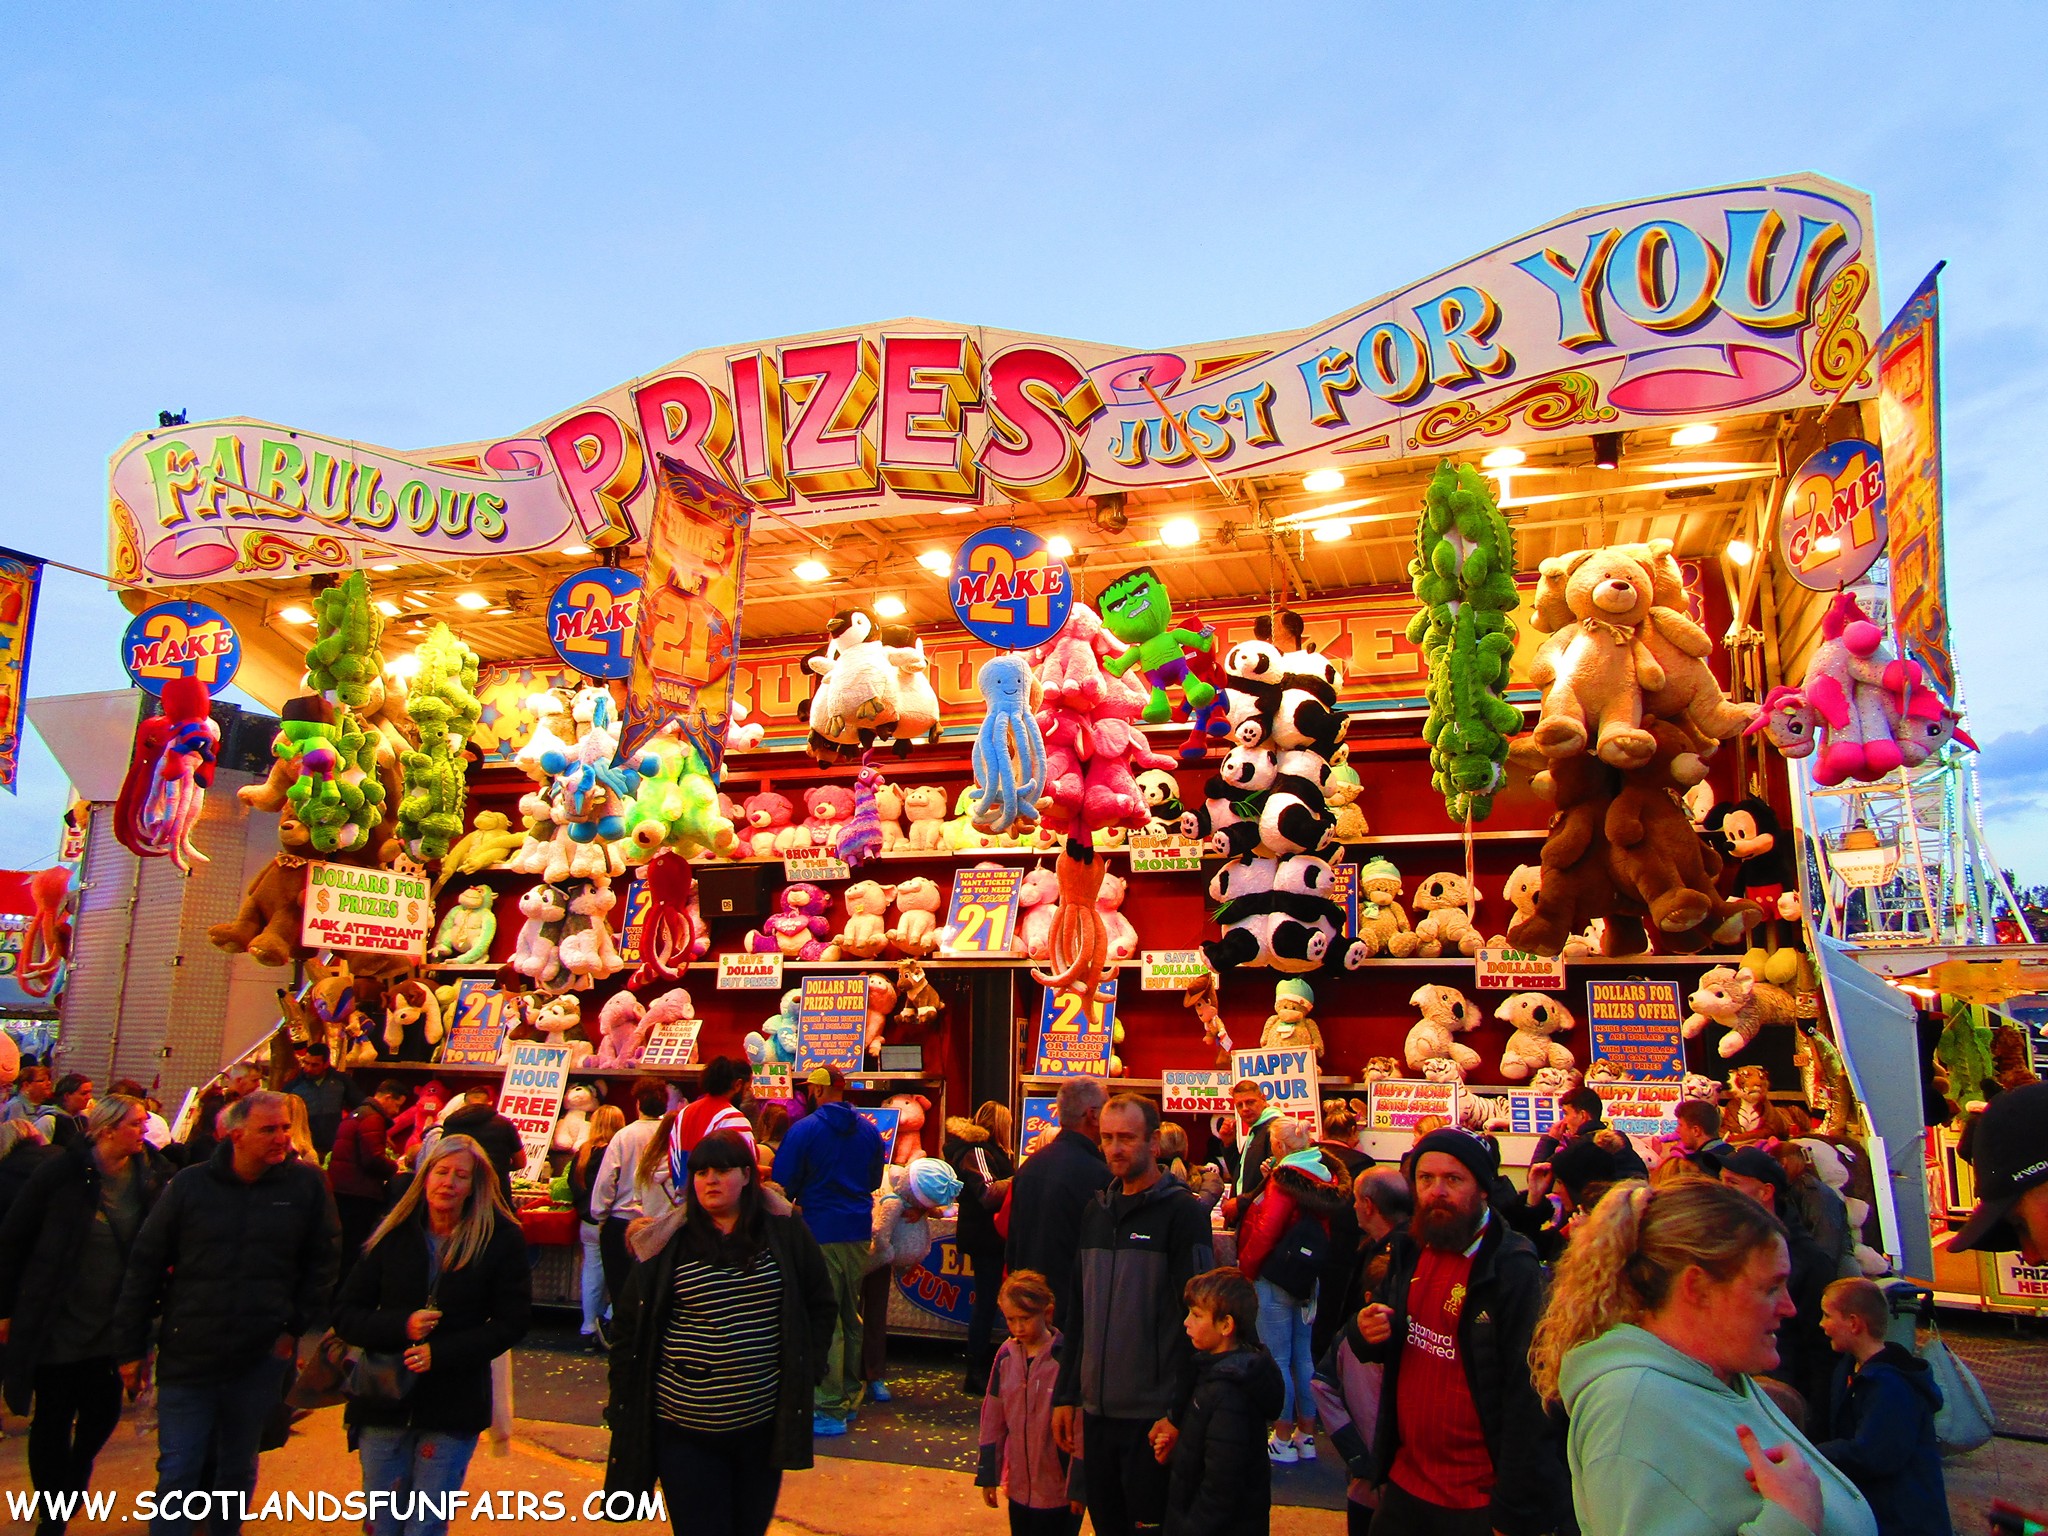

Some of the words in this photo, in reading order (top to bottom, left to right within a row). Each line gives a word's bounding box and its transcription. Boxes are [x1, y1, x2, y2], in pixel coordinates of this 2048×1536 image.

[1107, 381, 1278, 466] JUST
[1296, 285, 1516, 429] FOR
[1513, 209, 1847, 353] YOU
[541, 332, 1107, 548] PRIZES
[145, 434, 508, 542] FABULOUS
[1788, 460, 1884, 567] GAME
[1794, 450, 1877, 573] 21
[955, 565, 1065, 607] MAKE
[967, 544, 1050, 628] 21
[554, 601, 640, 643] MAK
[650, 592, 711, 683] 21
[130, 629, 233, 670] MAKE
[139, 614, 224, 684] 21
[659, 681, 691, 706] GAME
[1132, 836, 1174, 849] SHOW
[1178, 835, 1200, 847] ME
[786, 848, 821, 860] SHOW
[1152, 848, 1182, 858] THE
[803, 859, 829, 868] THE
[1133, 858, 1200, 872] MONEY
[788, 867, 846, 880] MONEY
[312, 865, 390, 894] DOLLARS
[394, 878, 426, 900] FOR
[338, 893, 399, 918] PRIZES
[308, 917, 340, 932] ASK
[344, 921, 424, 941] ATTENDANT
[950, 903, 1010, 951] 21
[323, 931, 352, 945] FOR
[355, 935, 409, 951] DETAILS
[622, 948, 640, 961] TO
[738, 955, 764, 965] SAVE
[1164, 952, 1196, 964] SAVE
[726, 966, 774, 976] DOLLARS
[1152, 965, 1209, 976] DOLLARS
[1487, 962, 1553, 974] DOLLARS
[721, 977, 742, 988] BUY
[744, 977, 779, 987] PRIZES
[806, 980, 845, 995] DOLLARS
[847, 979, 864, 994] FOR
[1145, 977, 1171, 990] BUY
[1480, 975, 1510, 988] BUY
[1512, 975, 1561, 988] PRIZES
[1593, 985, 1646, 1001] DOLLARS
[1649, 985, 1674, 1001] FOR
[459, 991, 505, 1028] 21
[803, 996, 835, 1011] PRIZES
[836, 995, 864, 1010] OFFER
[1593, 1003, 1635, 1019] PRIZES
[1638, 1003, 1677, 1020] OFFER
[452, 1027, 479, 1035] WITH
[481, 1028, 502, 1036] ONE
[1042, 1034, 1079, 1042] WITH
[1081, 1034, 1109, 1043] ONE
[1609, 1033, 1626, 1041] ARE
[453, 1042, 495, 1050] TICKETS
[1045, 1042, 1064, 1050] OR
[1066, 1043, 1104, 1051] MORE
[446, 1049, 465, 1063] TO
[467, 1050, 498, 1064] WIN
[514, 1047, 568, 1068] HAPPY
[1046, 1050, 1101, 1059] TICKETS
[769, 1064, 788, 1076] ME
[1039, 1058, 1063, 1073] TO
[1067, 1059, 1106, 1076] WIN
[1238, 1051, 1308, 1078] HAPPY
[1634, 1062, 1662, 1070] PRIZES
[509, 1069, 560, 1088] HOUR
[1165, 1072, 1212, 1086] SHOW
[751, 1085, 790, 1099] NEY
[1187, 1086, 1219, 1097] THE
[1258, 1078, 1309, 1100] OUR
[1373, 1082, 1416, 1098] HAPPY
[1414, 1083, 1453, 1099] HOUR
[1593, 1085, 1637, 1101] HAPPY
[1637, 1086, 1680, 1102] HOUR
[500, 1095, 558, 1117] FREE
[1408, 1099, 1449, 1113] SPECIAL
[1607, 1102, 1664, 1117] SPECIAL
[509, 1117, 550, 1134] CKETS
[1375, 1115, 1388, 1125] 30
[1612, 1118, 1660, 1135] TICKETS
[901, 1261, 961, 1312] FUN
